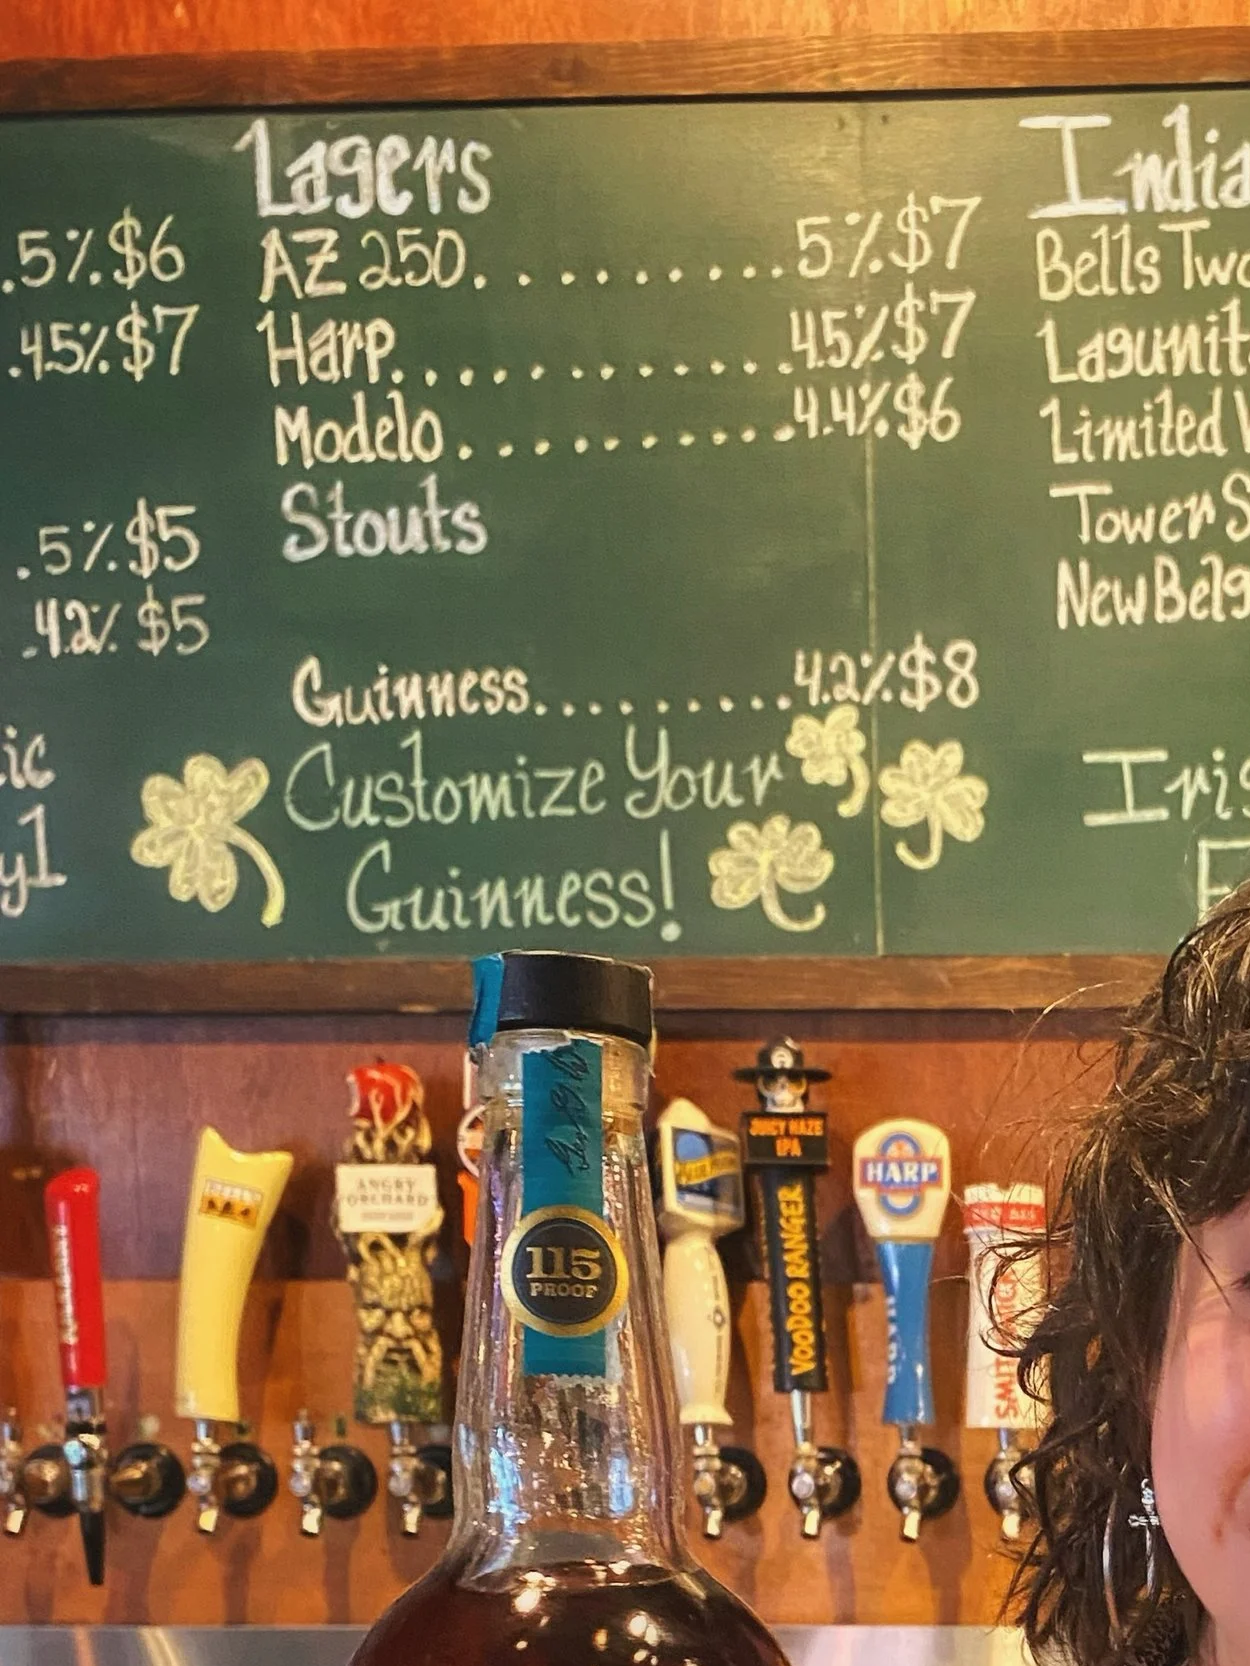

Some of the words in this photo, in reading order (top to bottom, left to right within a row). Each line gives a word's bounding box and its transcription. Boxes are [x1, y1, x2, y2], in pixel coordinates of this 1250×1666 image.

[233, 118, 494, 219] Lagers
[107, 205, 186, 290] $6
[259, 226, 348, 302] AZ
[361, 226, 467, 291] 250
[888, 191, 982, 275] $7
[1035, 222, 1163, 302] Bells
[115, 299, 200, 383] $7
[256, 310, 396, 387] Harp
[891, 281, 977, 365] $7
[274, 390, 444, 470] Modelo
[893, 371, 962, 451] $6
[1039, 387, 1229, 464] Limited
[125, 497, 201, 580] $5
[281, 473, 488, 563] Stouts
[1049, 483, 1216, 545] Tower
[136, 583, 210, 657] $5
[1056, 556, 1149, 630] New
[292, 655, 531, 728] Guinness
[898, 631, 980, 713] $8
[284, 729, 607, 832] Customize
[624, 720, 785, 820] Your
[346, 828, 683, 942] Guinness!
[865, 1160, 939, 1184] HARP
[524, 1244, 602, 1282] 115
[776, 1183, 811, 1280] RANGER
[529, 1281, 599, 1299] PROOF
[784, 1278, 817, 1376] VOODOO
